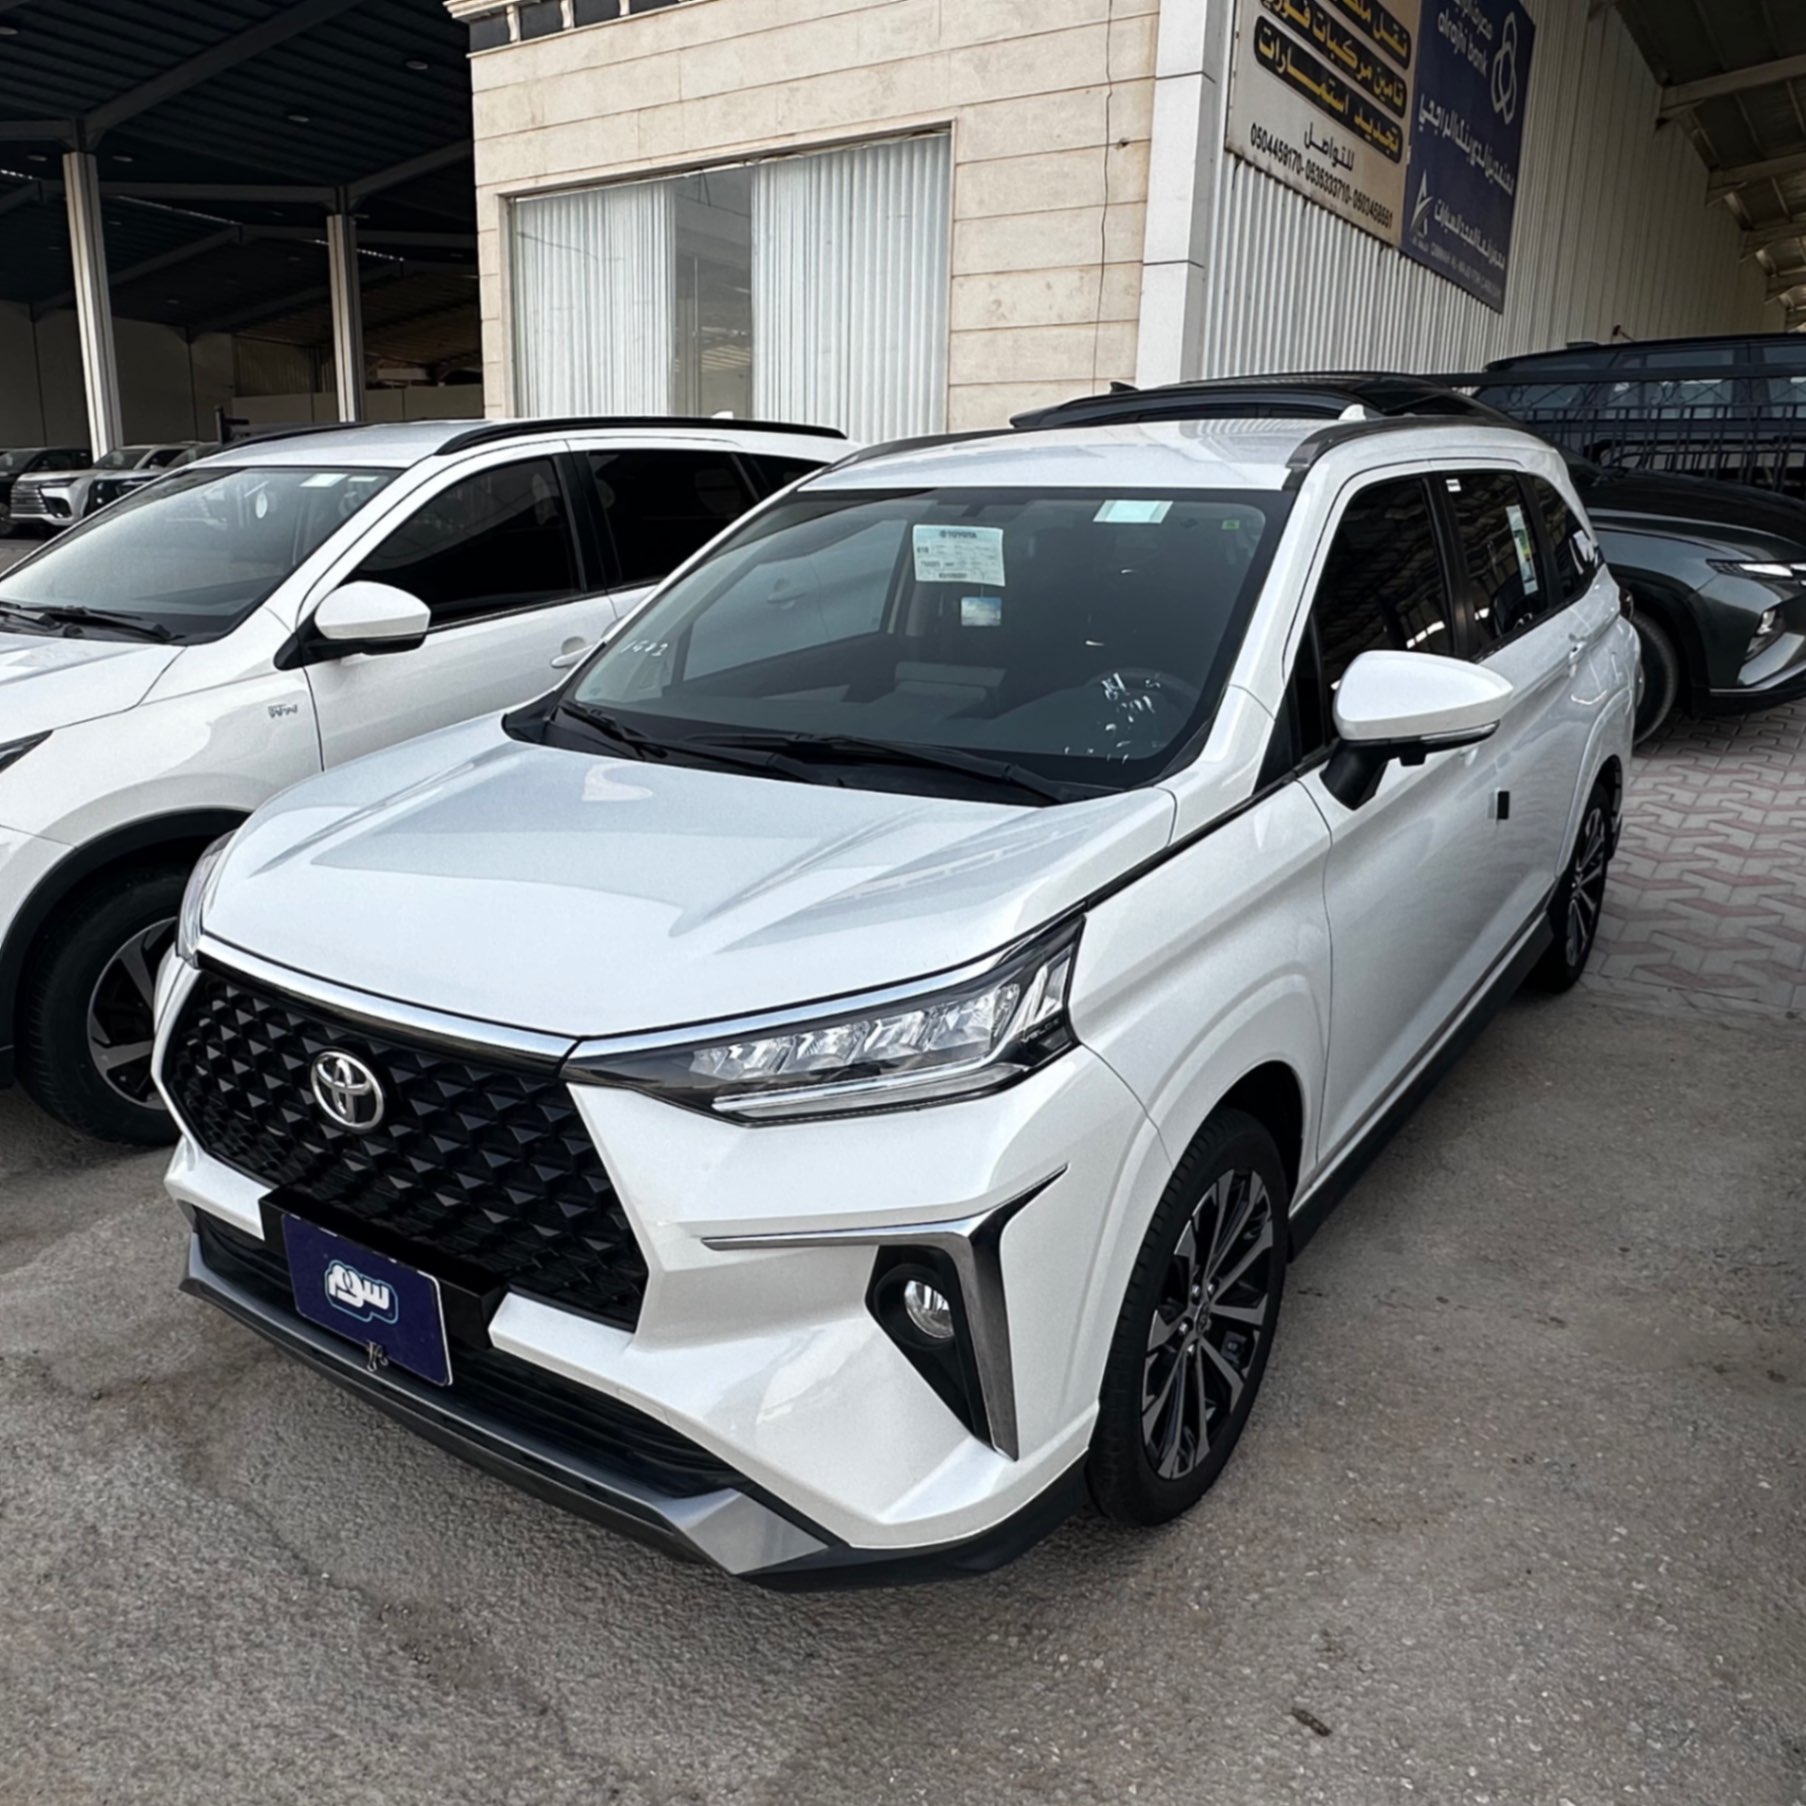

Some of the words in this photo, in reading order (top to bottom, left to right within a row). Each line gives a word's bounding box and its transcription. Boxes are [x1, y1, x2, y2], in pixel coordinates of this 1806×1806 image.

[1312, 9, 1373, 80] مركبات
[1258, 26, 1350, 115] استمارات
[1304, 121, 1355, 171] للتواصل
[1353, 105, 1400, 155] تجديد
[328, 1264, 390, 1310] سوم
